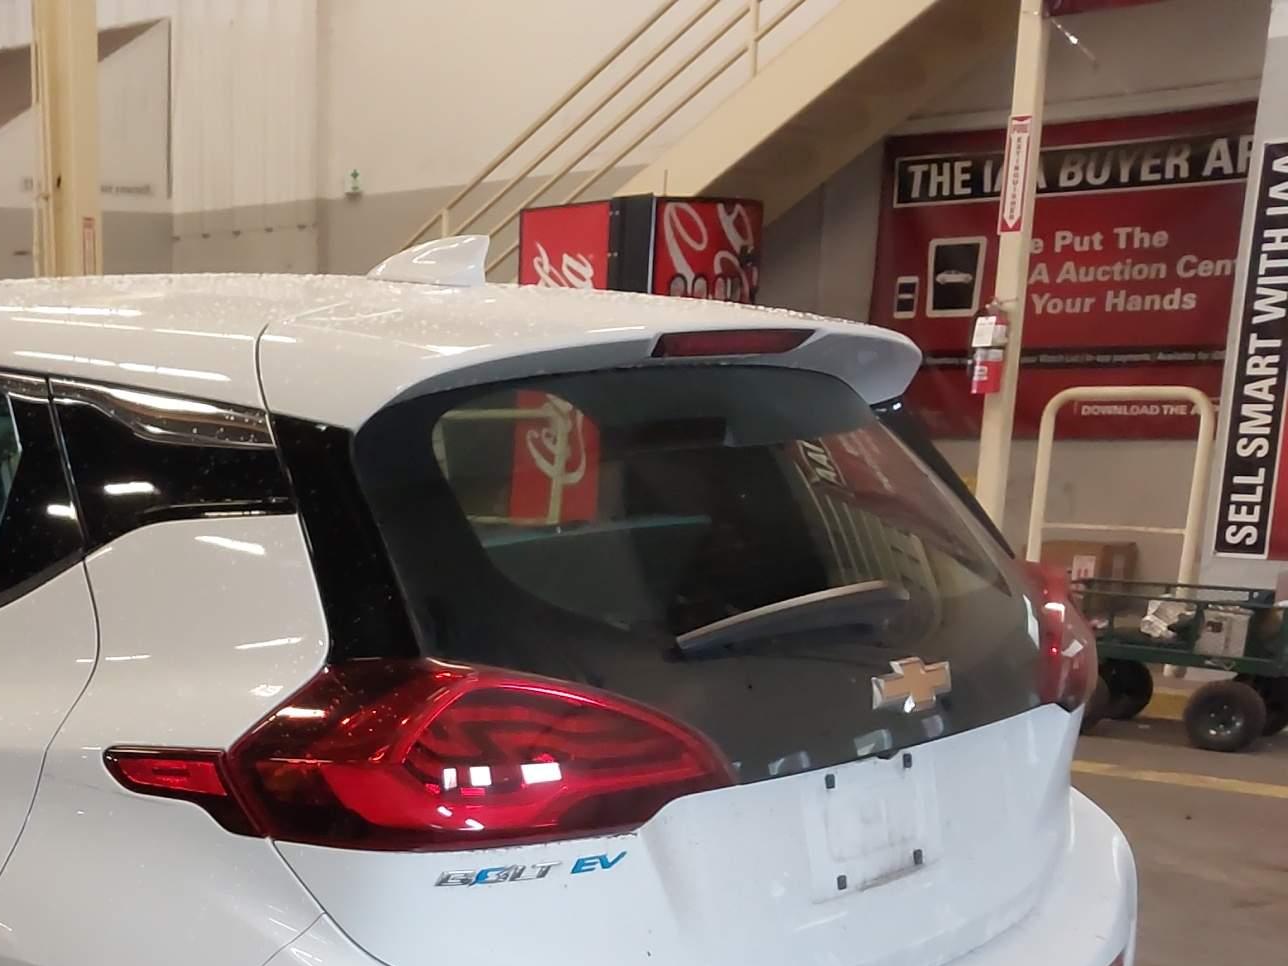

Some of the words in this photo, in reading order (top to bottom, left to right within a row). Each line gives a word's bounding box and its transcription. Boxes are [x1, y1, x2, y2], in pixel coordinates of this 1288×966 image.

[907, 160, 973, 199] THE
[1059, 143, 1191, 188] BUYER
[1054, 230, 1104, 252] Put
[1113, 226, 1169, 249] The
[1056, 259, 1167, 284] Auction
[1252, 229, 1288, 325] WITH
[1031, 292, 1096, 315] Your
[1105, 287, 1198, 313] Hands
[1081, 404, 1160, 416] DOWNLOAD
[1162, 404, 1188, 415] THE
[1236, 333, 1283, 458] SMART
[1225, 467, 1266, 546] SELL
[434, 859, 563, 888] BOLT
[570, 850, 628, 875] EV
